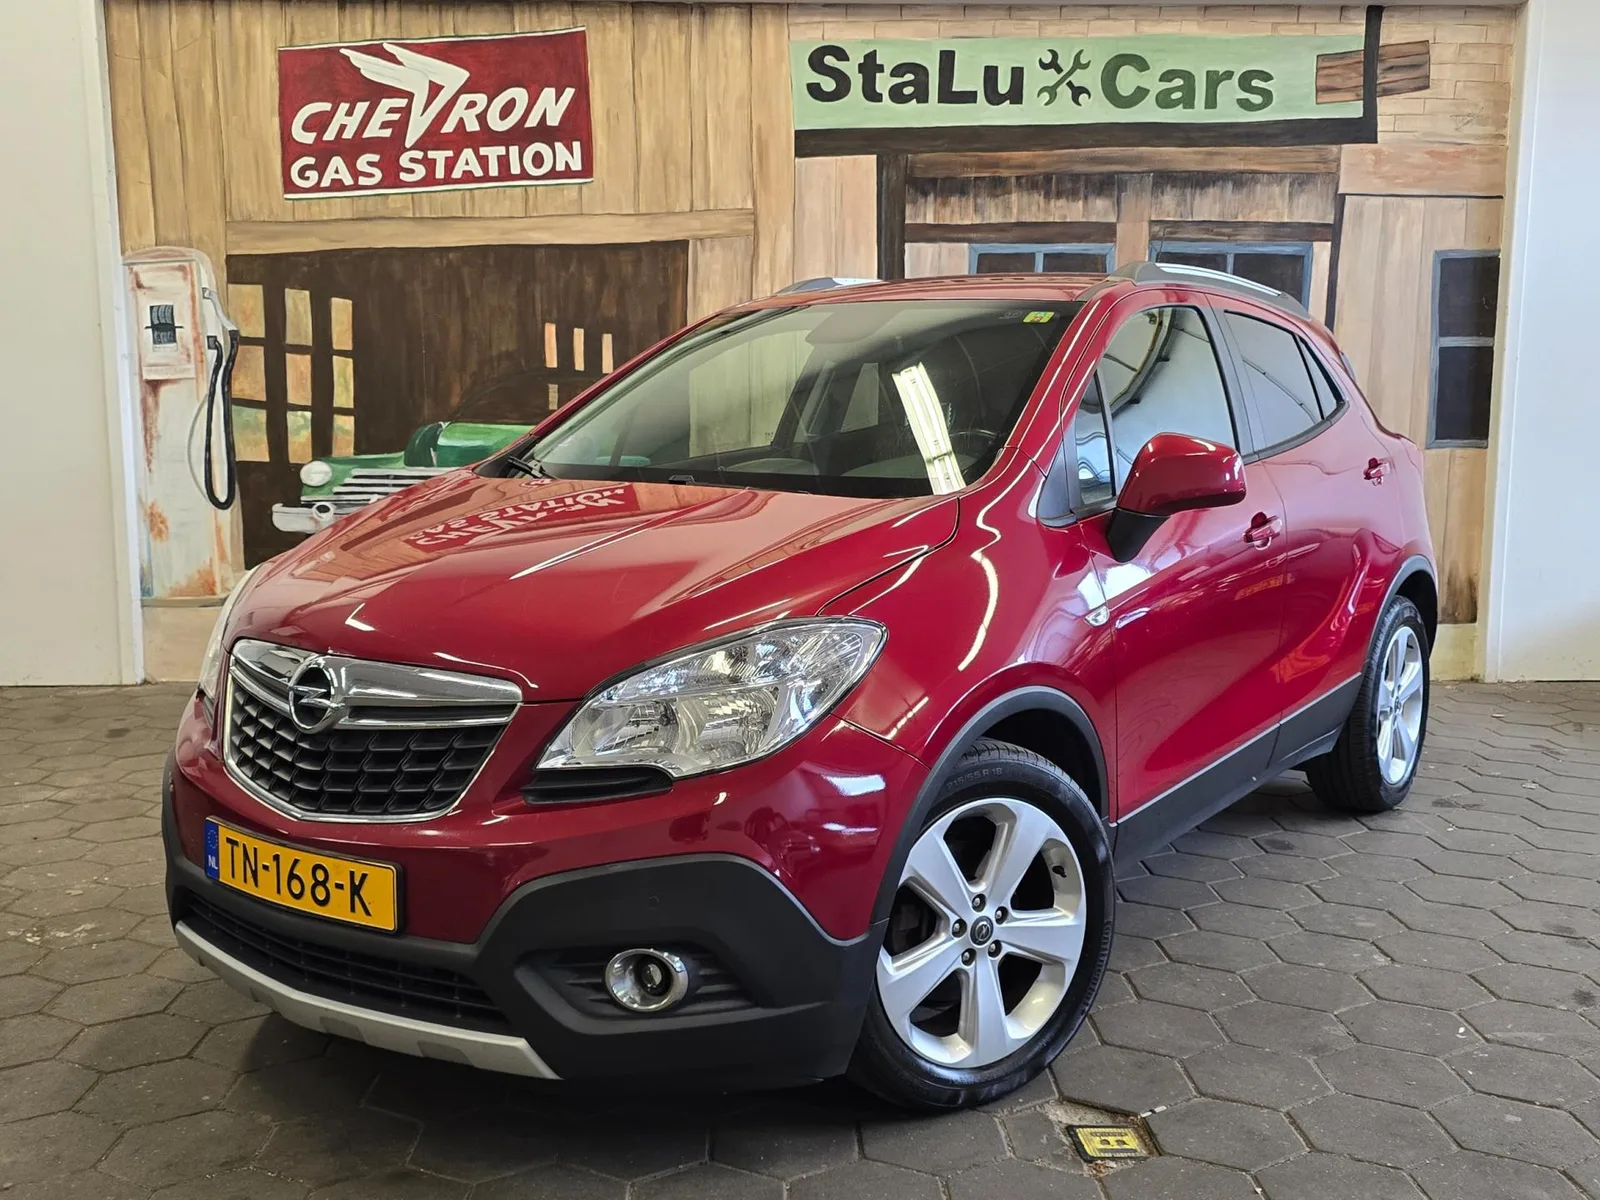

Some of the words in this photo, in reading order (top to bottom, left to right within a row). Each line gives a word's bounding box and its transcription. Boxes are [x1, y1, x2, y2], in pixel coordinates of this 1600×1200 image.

[290, 70, 576, 149] CHEVRON
[805, 44, 1025, 107] StaLu
[1100, 53, 1275, 112] Cars
[290, 153, 383, 188] GAS
[399, 141, 582, 182] STATION
[208, 854, 218, 870] NL
[225, 836, 372, 917] TN-168-K
